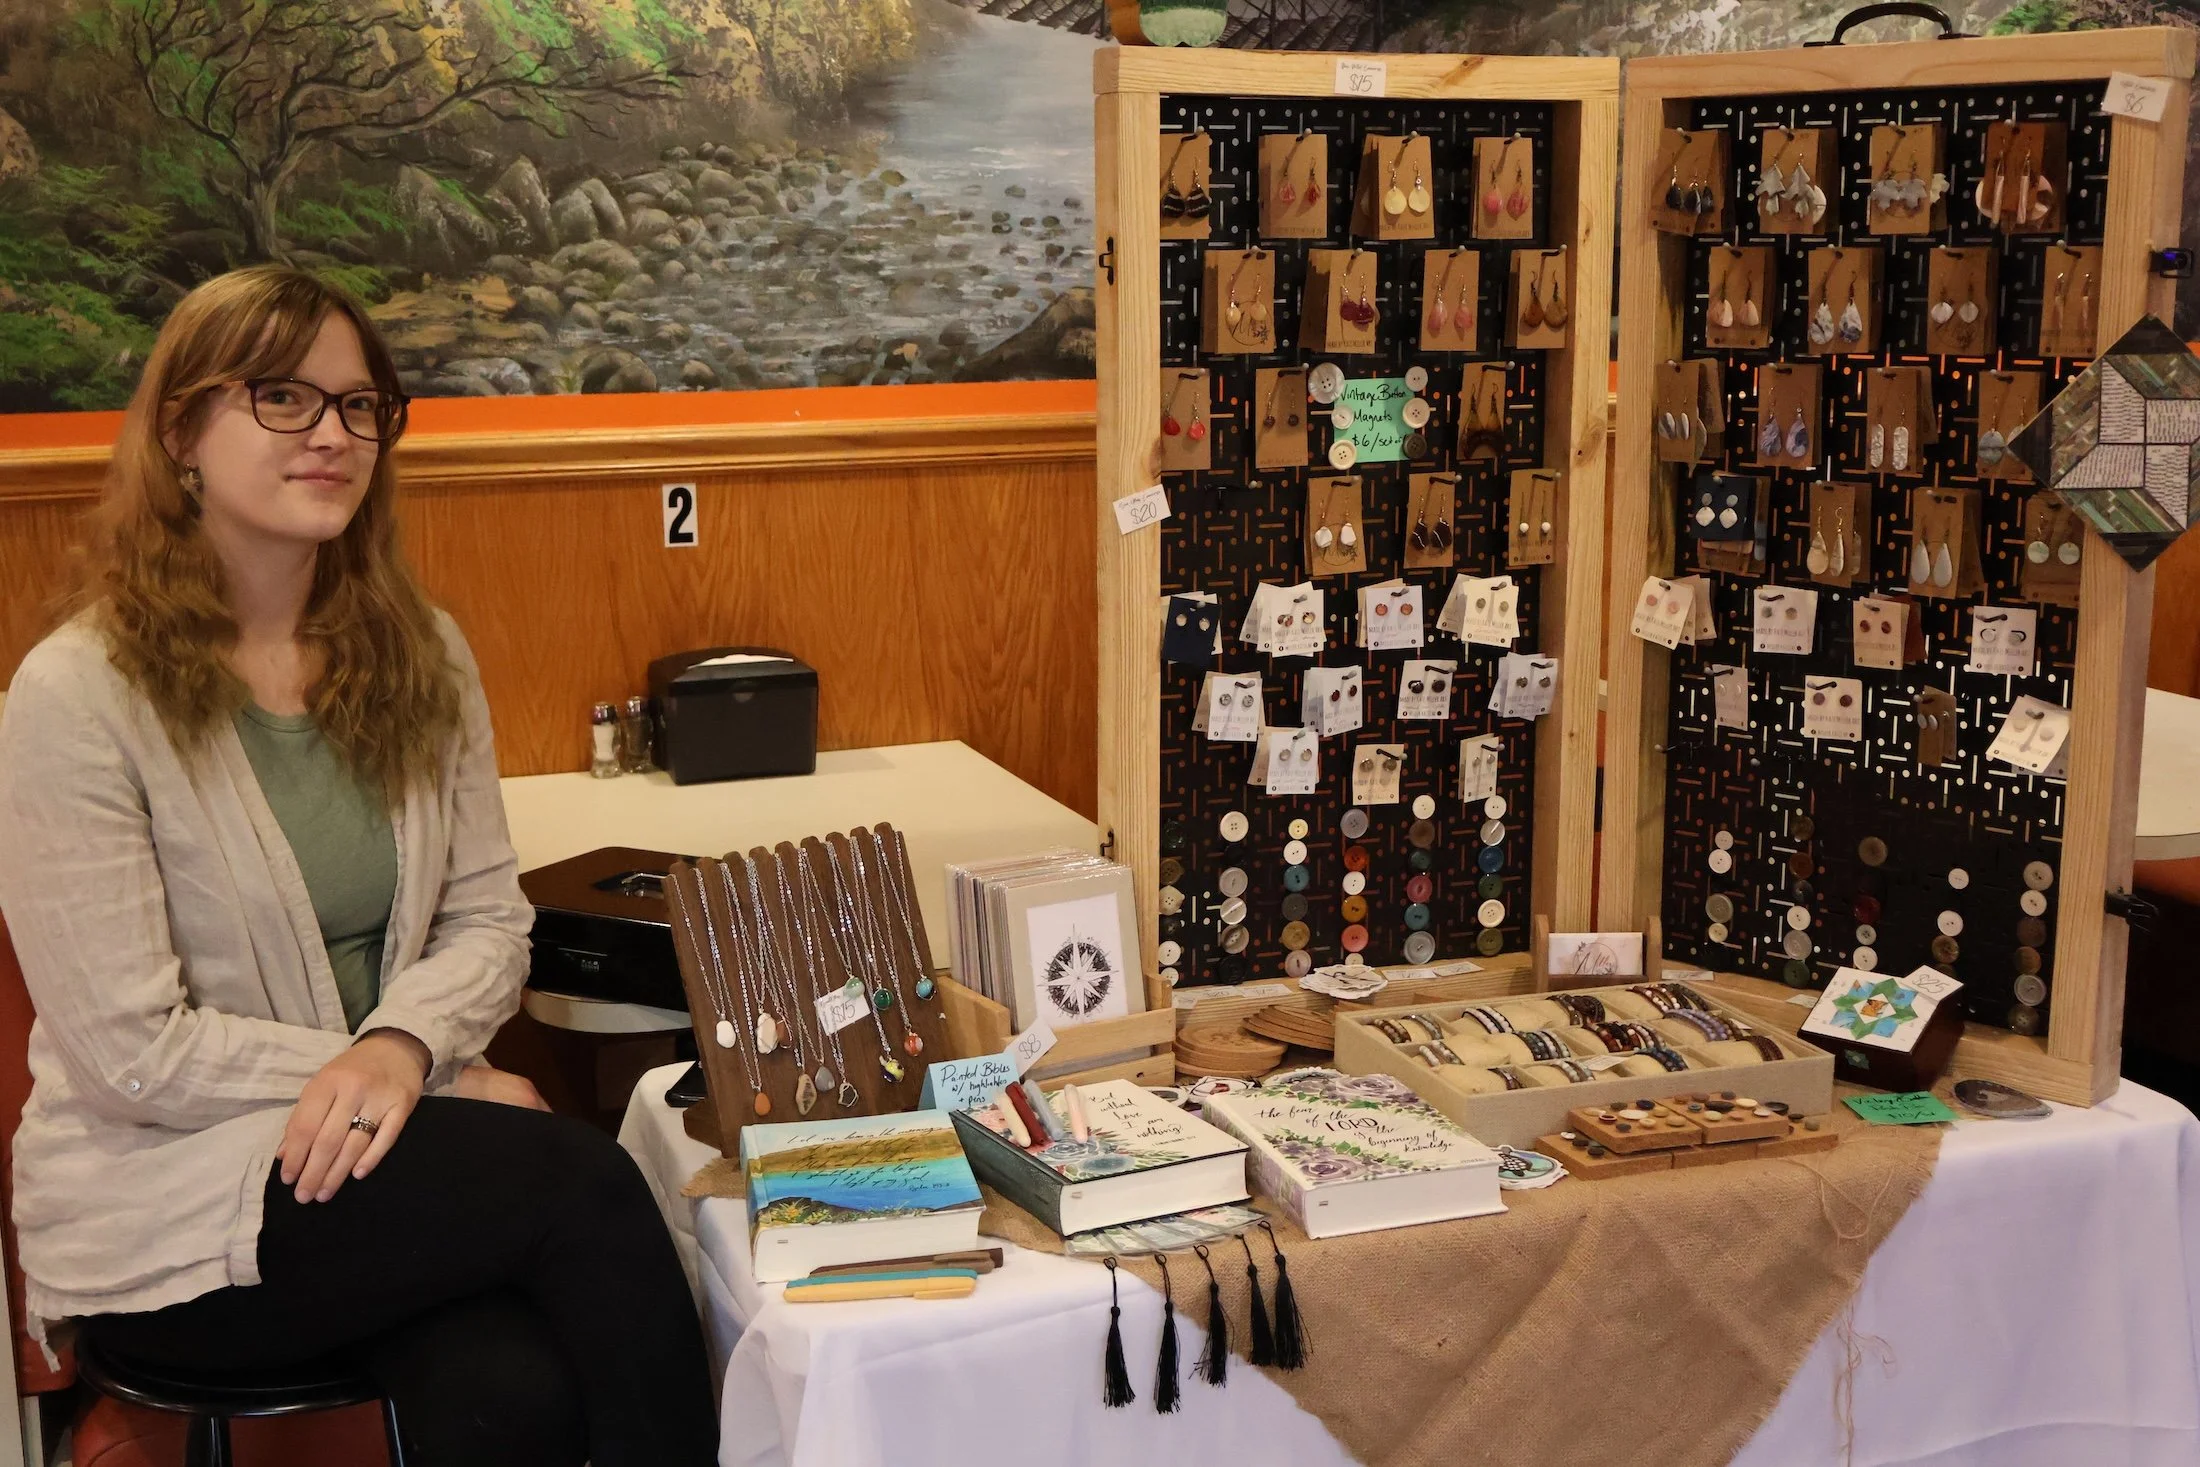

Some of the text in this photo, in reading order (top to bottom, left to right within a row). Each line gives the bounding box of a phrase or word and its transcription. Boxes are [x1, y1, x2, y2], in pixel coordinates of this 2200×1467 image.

[1350, 73, 1373, 93] $15
[1341, 384, 1378, 407] Vintage
[1354, 409, 1393, 431] Magnets
[668, 487, 694, 544] 2
[1130, 502, 1157, 525] $20
[1912, 974, 1950, 993] $25
[832, 999, 856, 1023] $15
[940, 1062, 1011, 1087] Painted Bibles
[968, 1095, 986, 1106] pens
[1100, 1098, 1138, 1113] without
[1147, 1117, 1164, 1125] am
[1254, 1105, 1318, 1119] the fear
[1305, 1109, 1356, 1128] of the
[1404, 1140, 1455, 1153] knowledge
